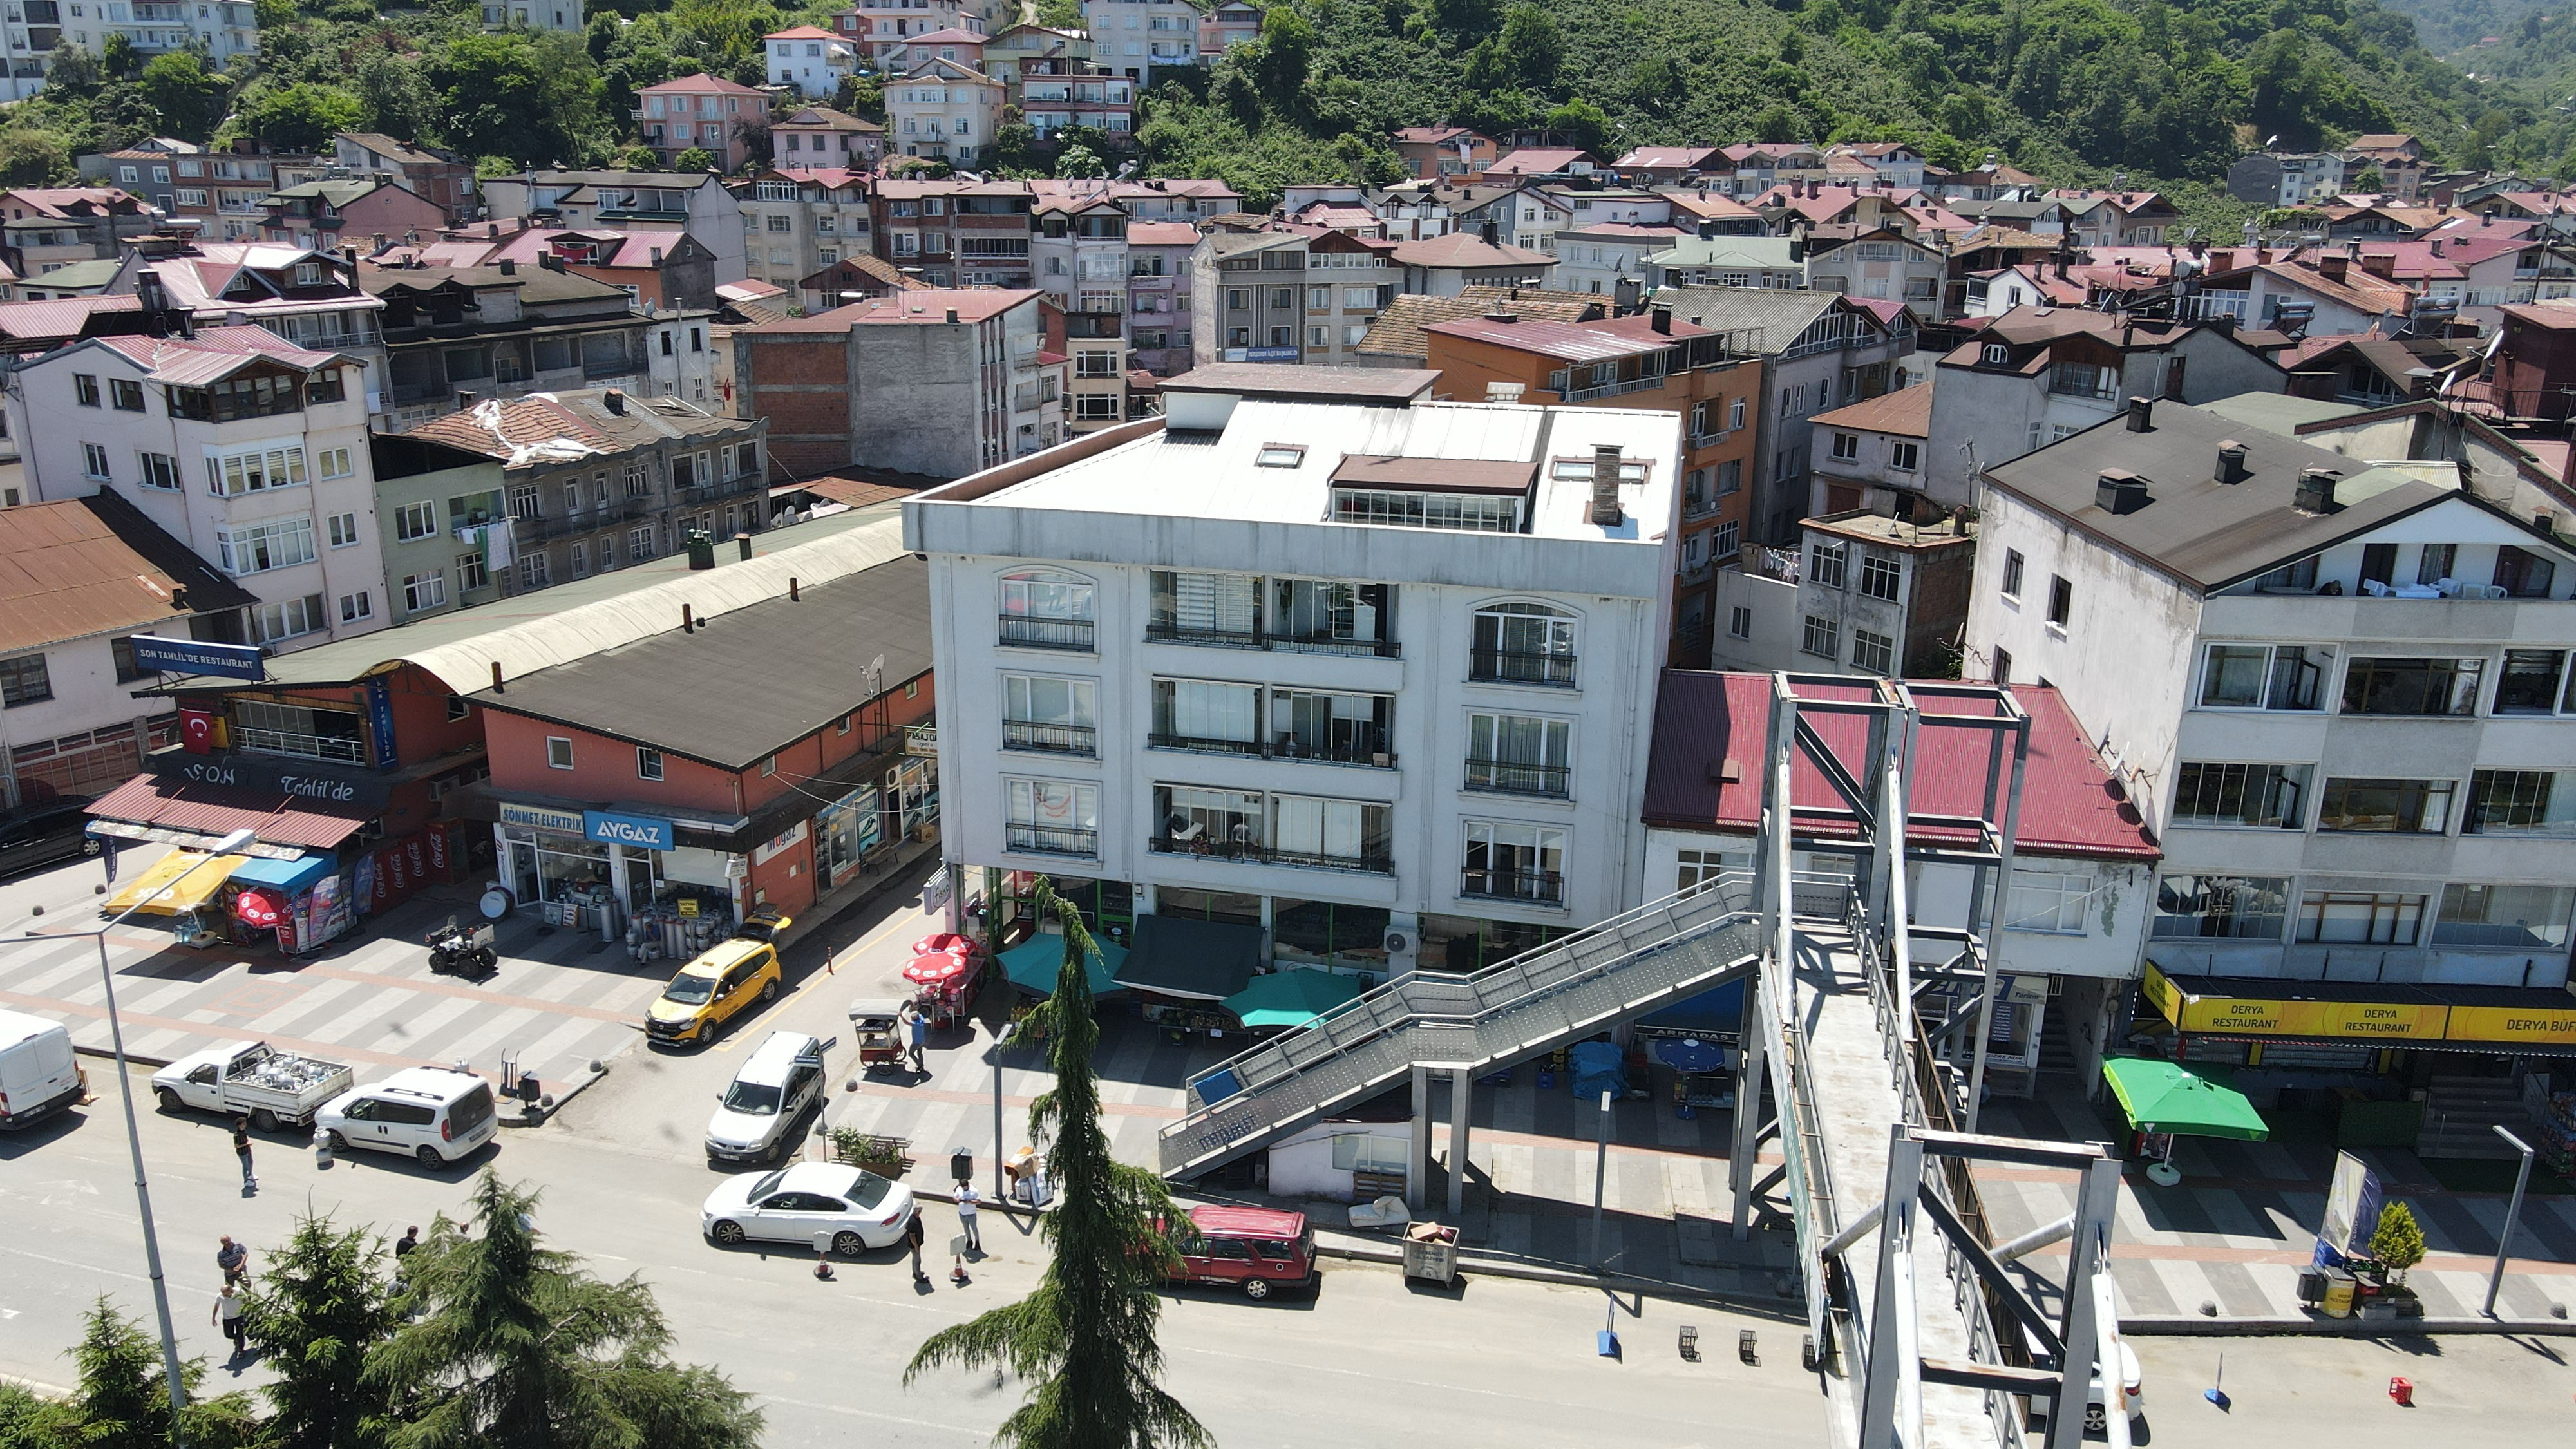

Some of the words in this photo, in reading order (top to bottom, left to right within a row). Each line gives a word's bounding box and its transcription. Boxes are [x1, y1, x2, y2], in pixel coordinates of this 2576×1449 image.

[140, 649, 157, 658] SON
[200, 655, 253, 669] RESTAURANT
[502, 806, 540, 826] SÖNMEZ
[541, 814, 582, 831] ELEKTRİK
[596, 820, 660, 844] AYGAZ
[2231, 1005, 2264, 1015] DERYA
[2364, 1009, 2397, 1018] DERYA
[2212, 1018, 2279, 1028] RESTAURANT
[2345, 1021, 2412, 1032] RESTAURANT
[2506, 1019, 2547, 1031] DERYA
[2551, 1018, 2576, 1032] BÜF
